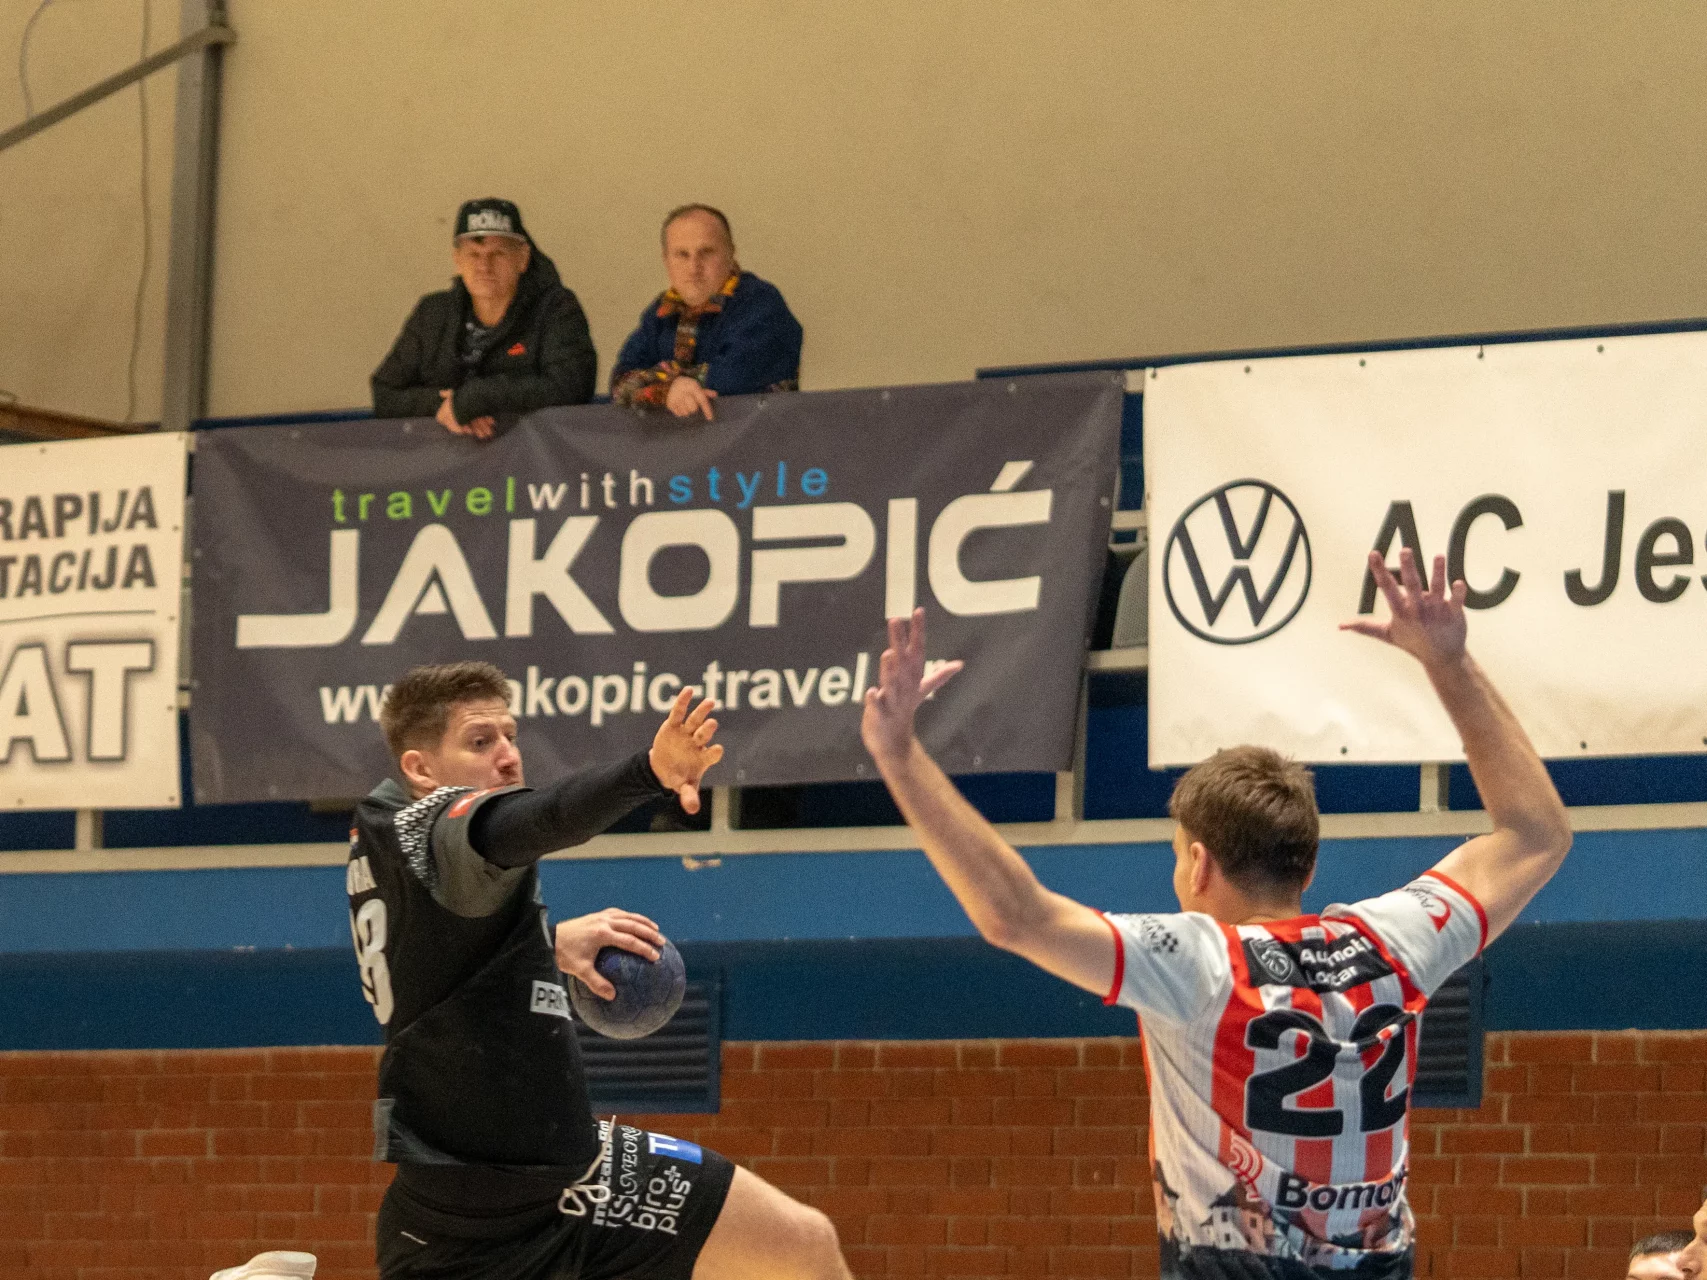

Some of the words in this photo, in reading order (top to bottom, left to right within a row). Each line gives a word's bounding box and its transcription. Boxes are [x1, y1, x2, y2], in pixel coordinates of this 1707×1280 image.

[236, 460, 1053, 648] JAKOPIĆ
[1358, 493, 1523, 615] AC
[1564, 489, 1707, 606] Je
[1245, 1003, 1410, 1138] 22
[629, 1177, 667, 1230] biro
